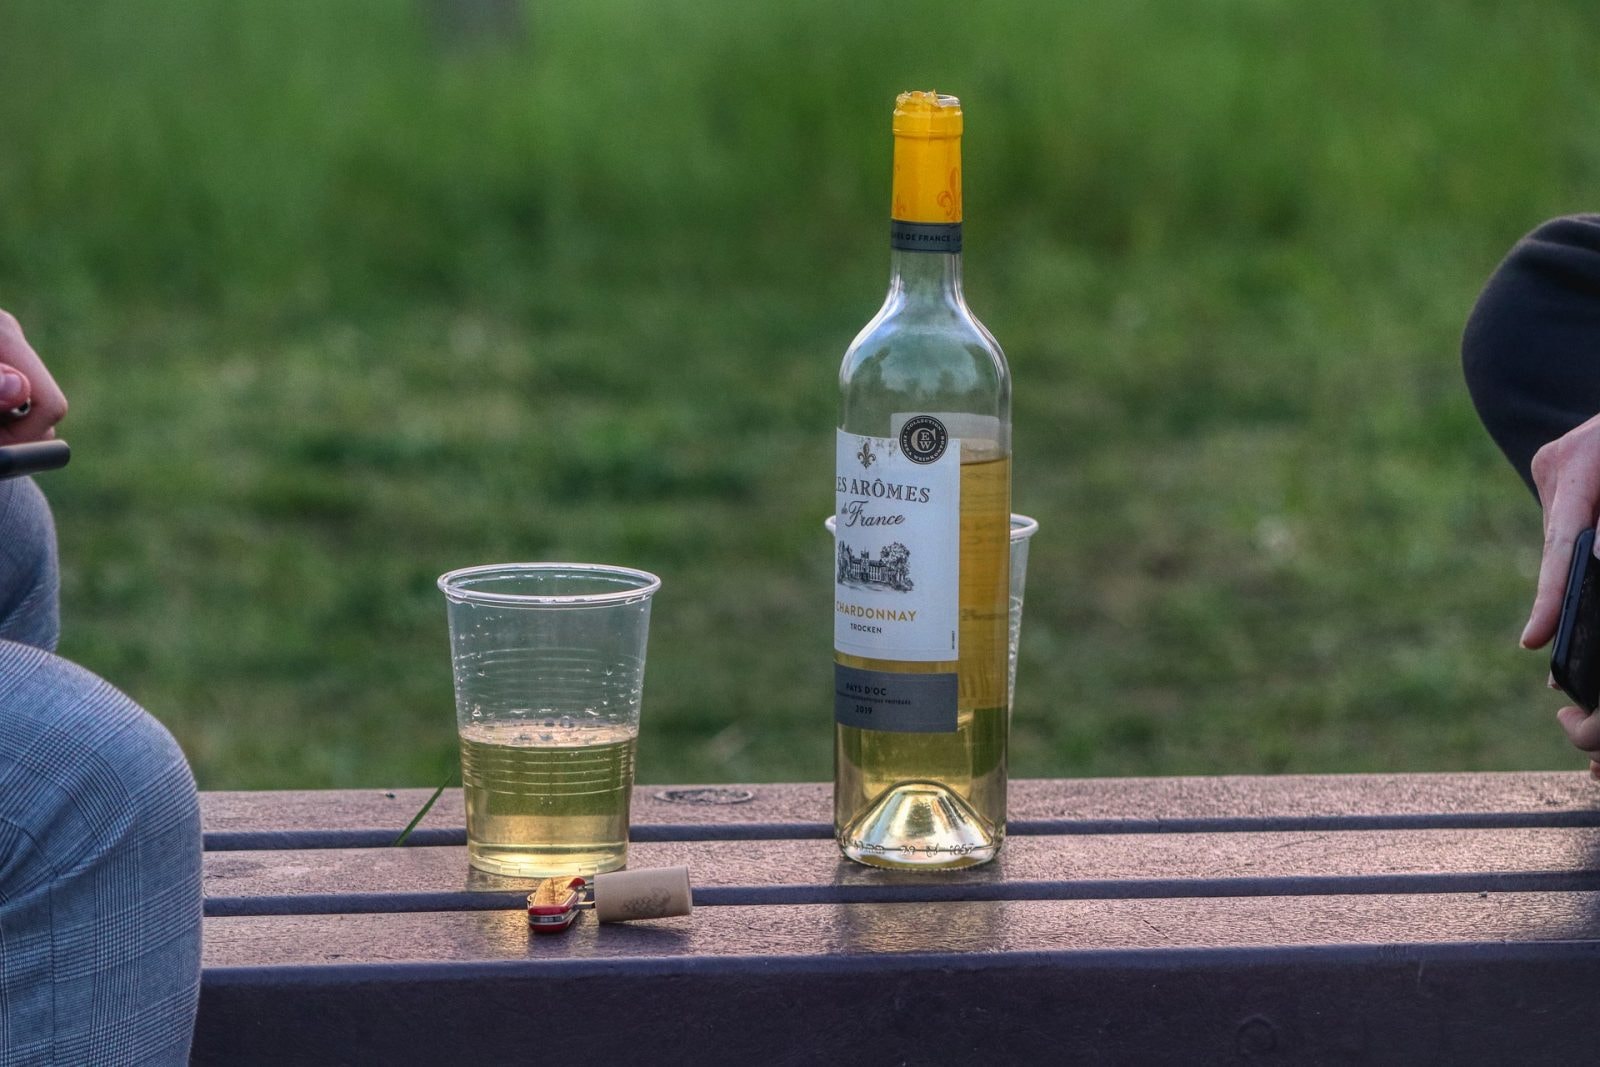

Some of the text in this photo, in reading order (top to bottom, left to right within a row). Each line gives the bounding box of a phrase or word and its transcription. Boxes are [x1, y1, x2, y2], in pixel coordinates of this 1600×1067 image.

[918, 234, 951, 242] FRANCE
[836, 476, 931, 504] ES ARÔMES
[845, 500, 906, 528] France
[836, 602, 917, 622] CHARDONNAY
[850, 622, 882, 634] TROCKEN
[846, 682, 888, 697] PAYS D'OC
[855, 705, 873, 715] 2019
